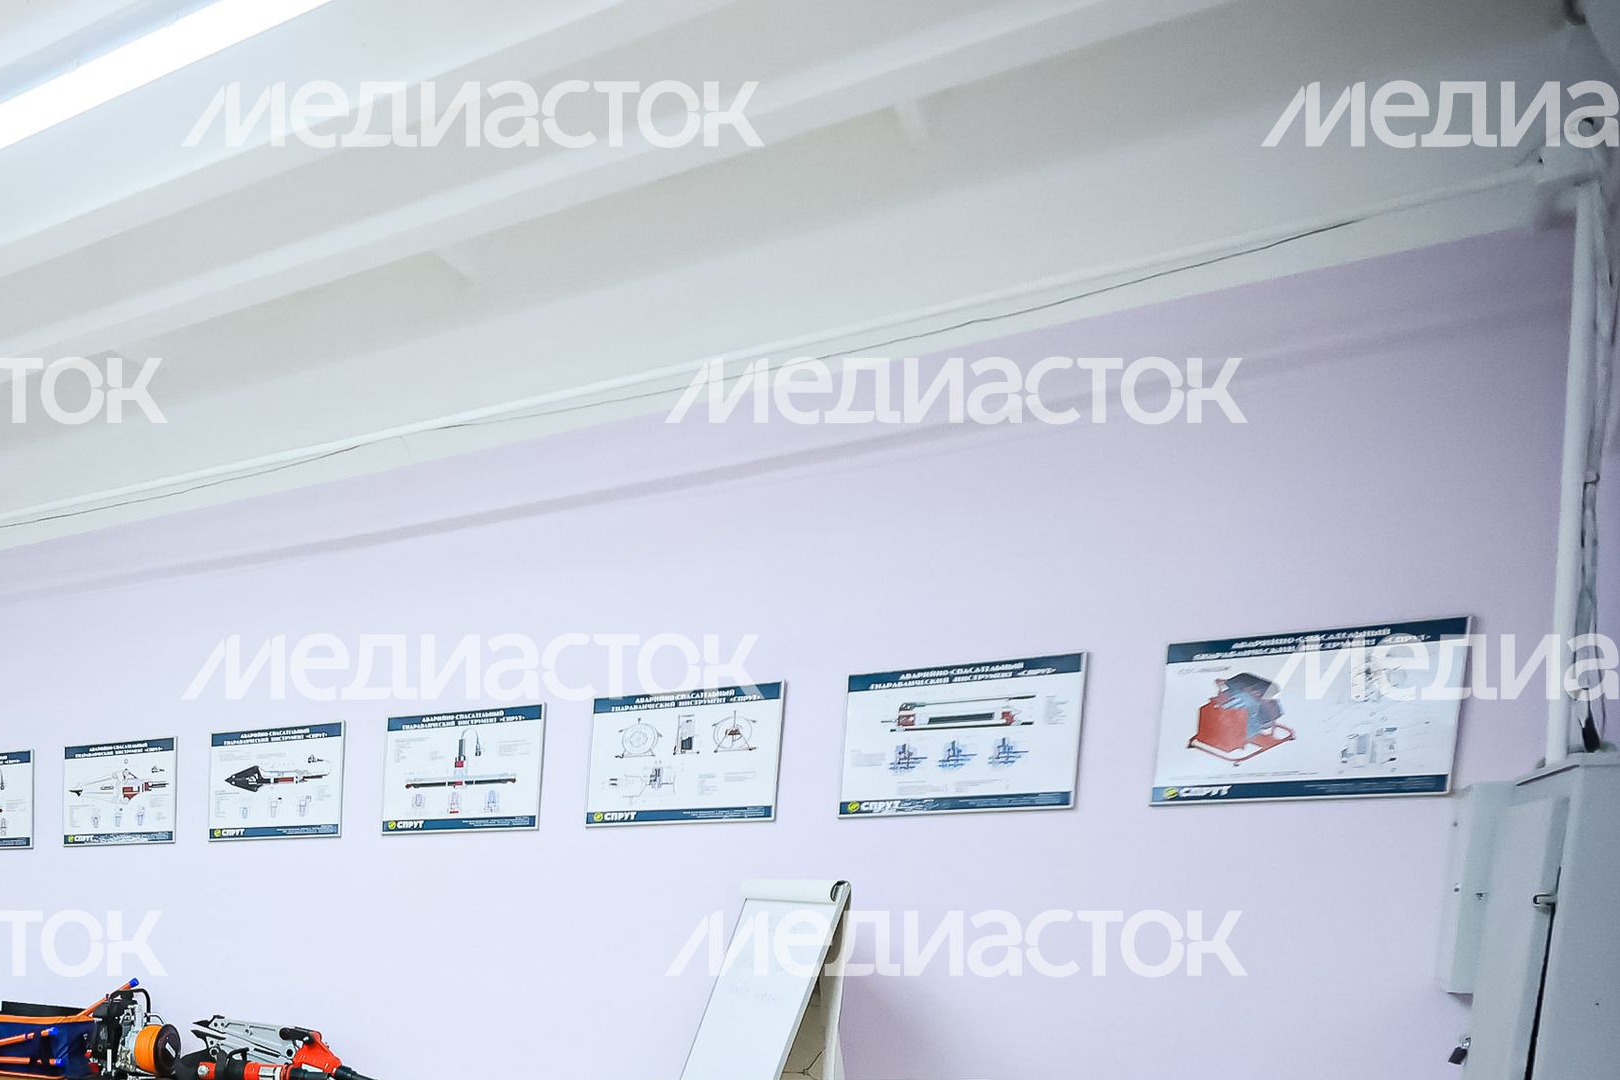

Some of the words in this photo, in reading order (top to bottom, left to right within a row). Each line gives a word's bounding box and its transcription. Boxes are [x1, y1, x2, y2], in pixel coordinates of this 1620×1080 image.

[860, 800, 901, 813] СПРУТ
[603, 811, 637, 821] СПРУТ
[396, 820, 424, 829] СПРУТ
[221, 828, 245, 836] СПРУТ
